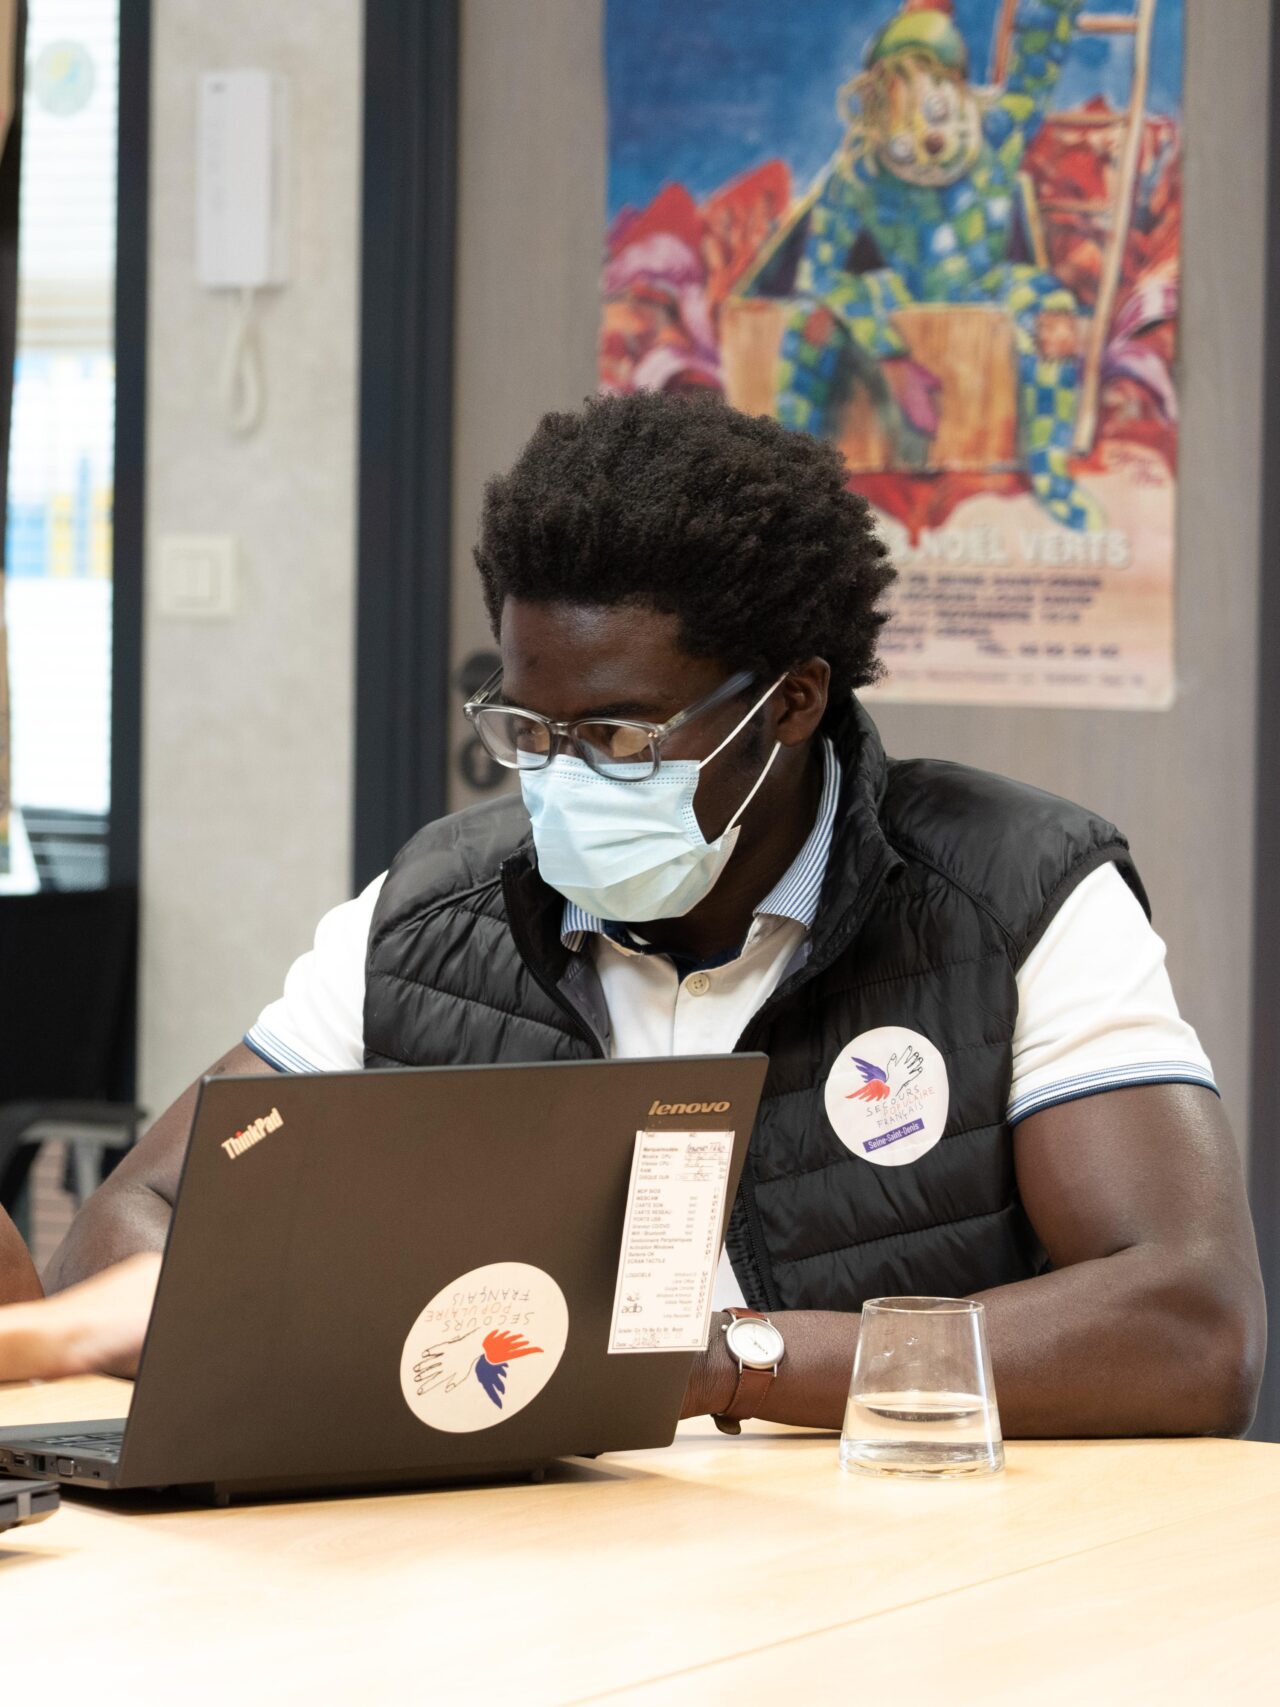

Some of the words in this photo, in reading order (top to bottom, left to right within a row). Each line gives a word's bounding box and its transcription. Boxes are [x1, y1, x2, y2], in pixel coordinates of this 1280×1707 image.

[648, 1100, 731, 1116] lenovo
[866, 1084, 920, 1117] SECOURS
[882, 1087, 936, 1117] POPULAIRE
[221, 1107, 284, 1160] ThinkPad
[867, 1121, 921, 1150] Seine-Saint-Denis
[452, 1285, 531, 1305] FRANÇAIS
[423, 1302, 512, 1322] POPULAIRE
[442, 1311, 536, 1333] SECOURS
